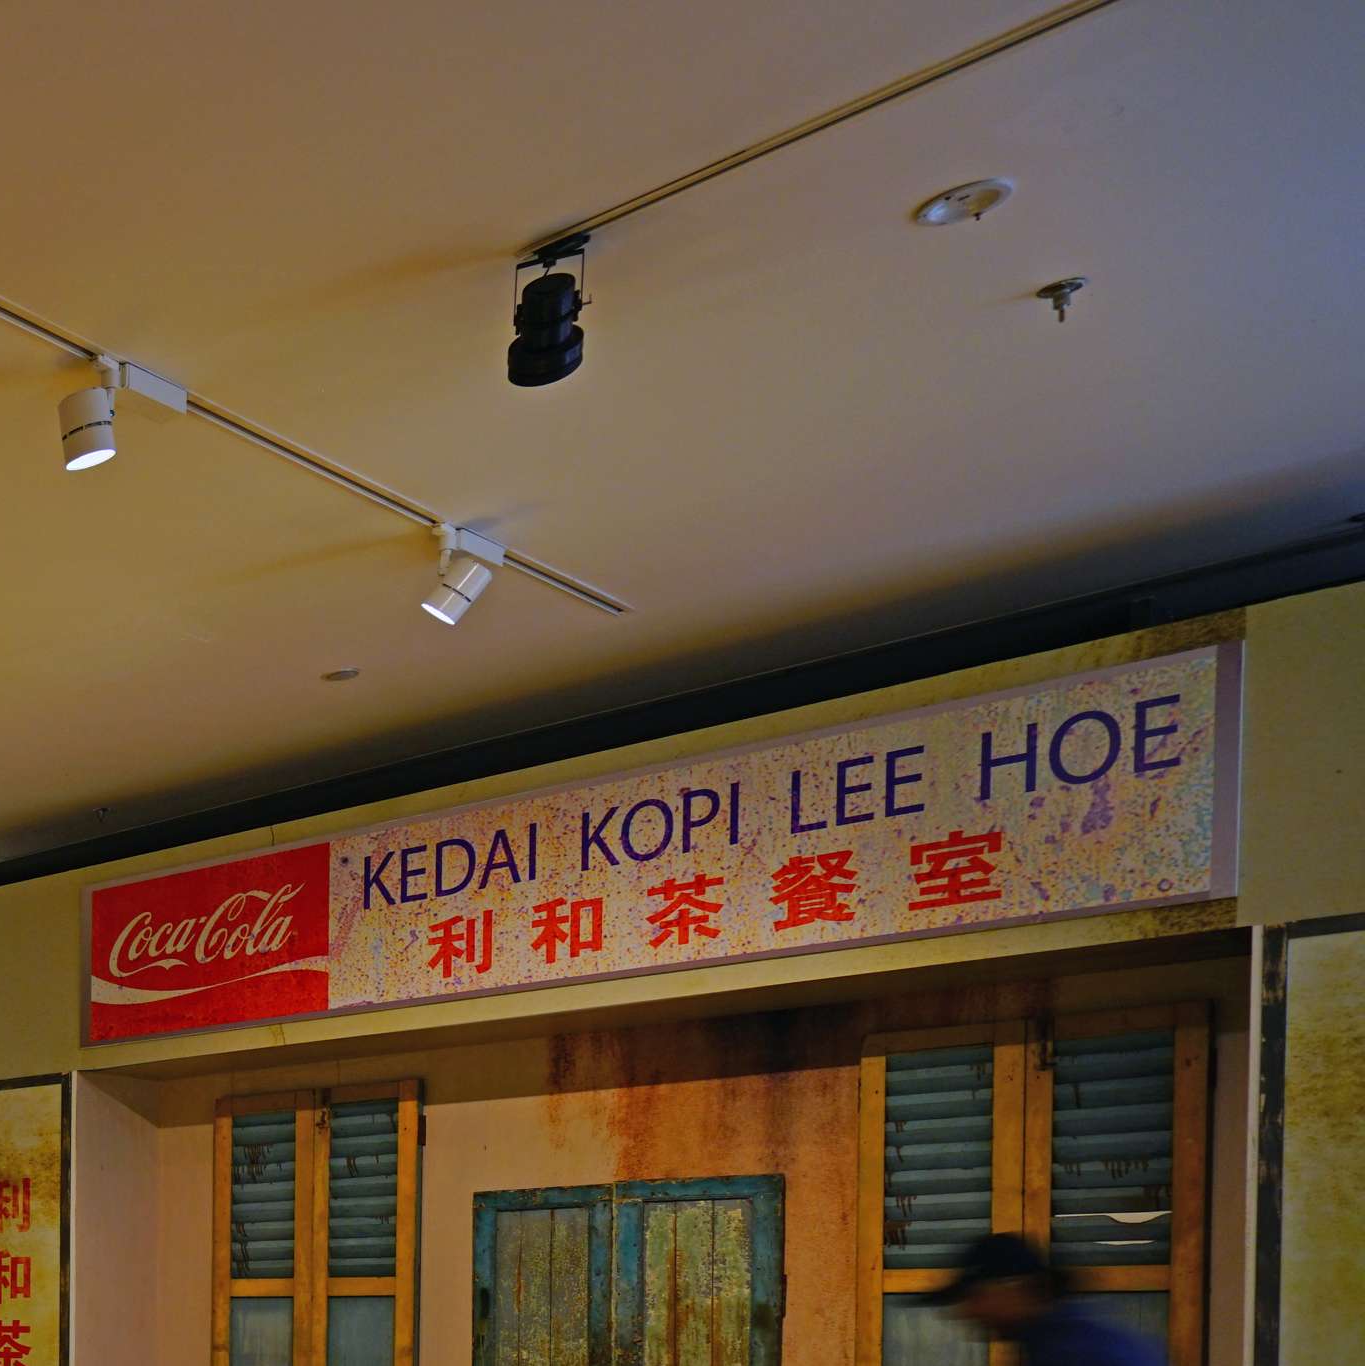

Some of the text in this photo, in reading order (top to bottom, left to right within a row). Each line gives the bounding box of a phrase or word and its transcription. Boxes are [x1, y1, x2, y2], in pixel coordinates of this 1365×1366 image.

[363, 694, 1182, 911] KEDAI KOPI LEE HOE
[108, 882, 307, 978] Coca-Cola
[427, 830, 1002, 980] 利和茶餐室
